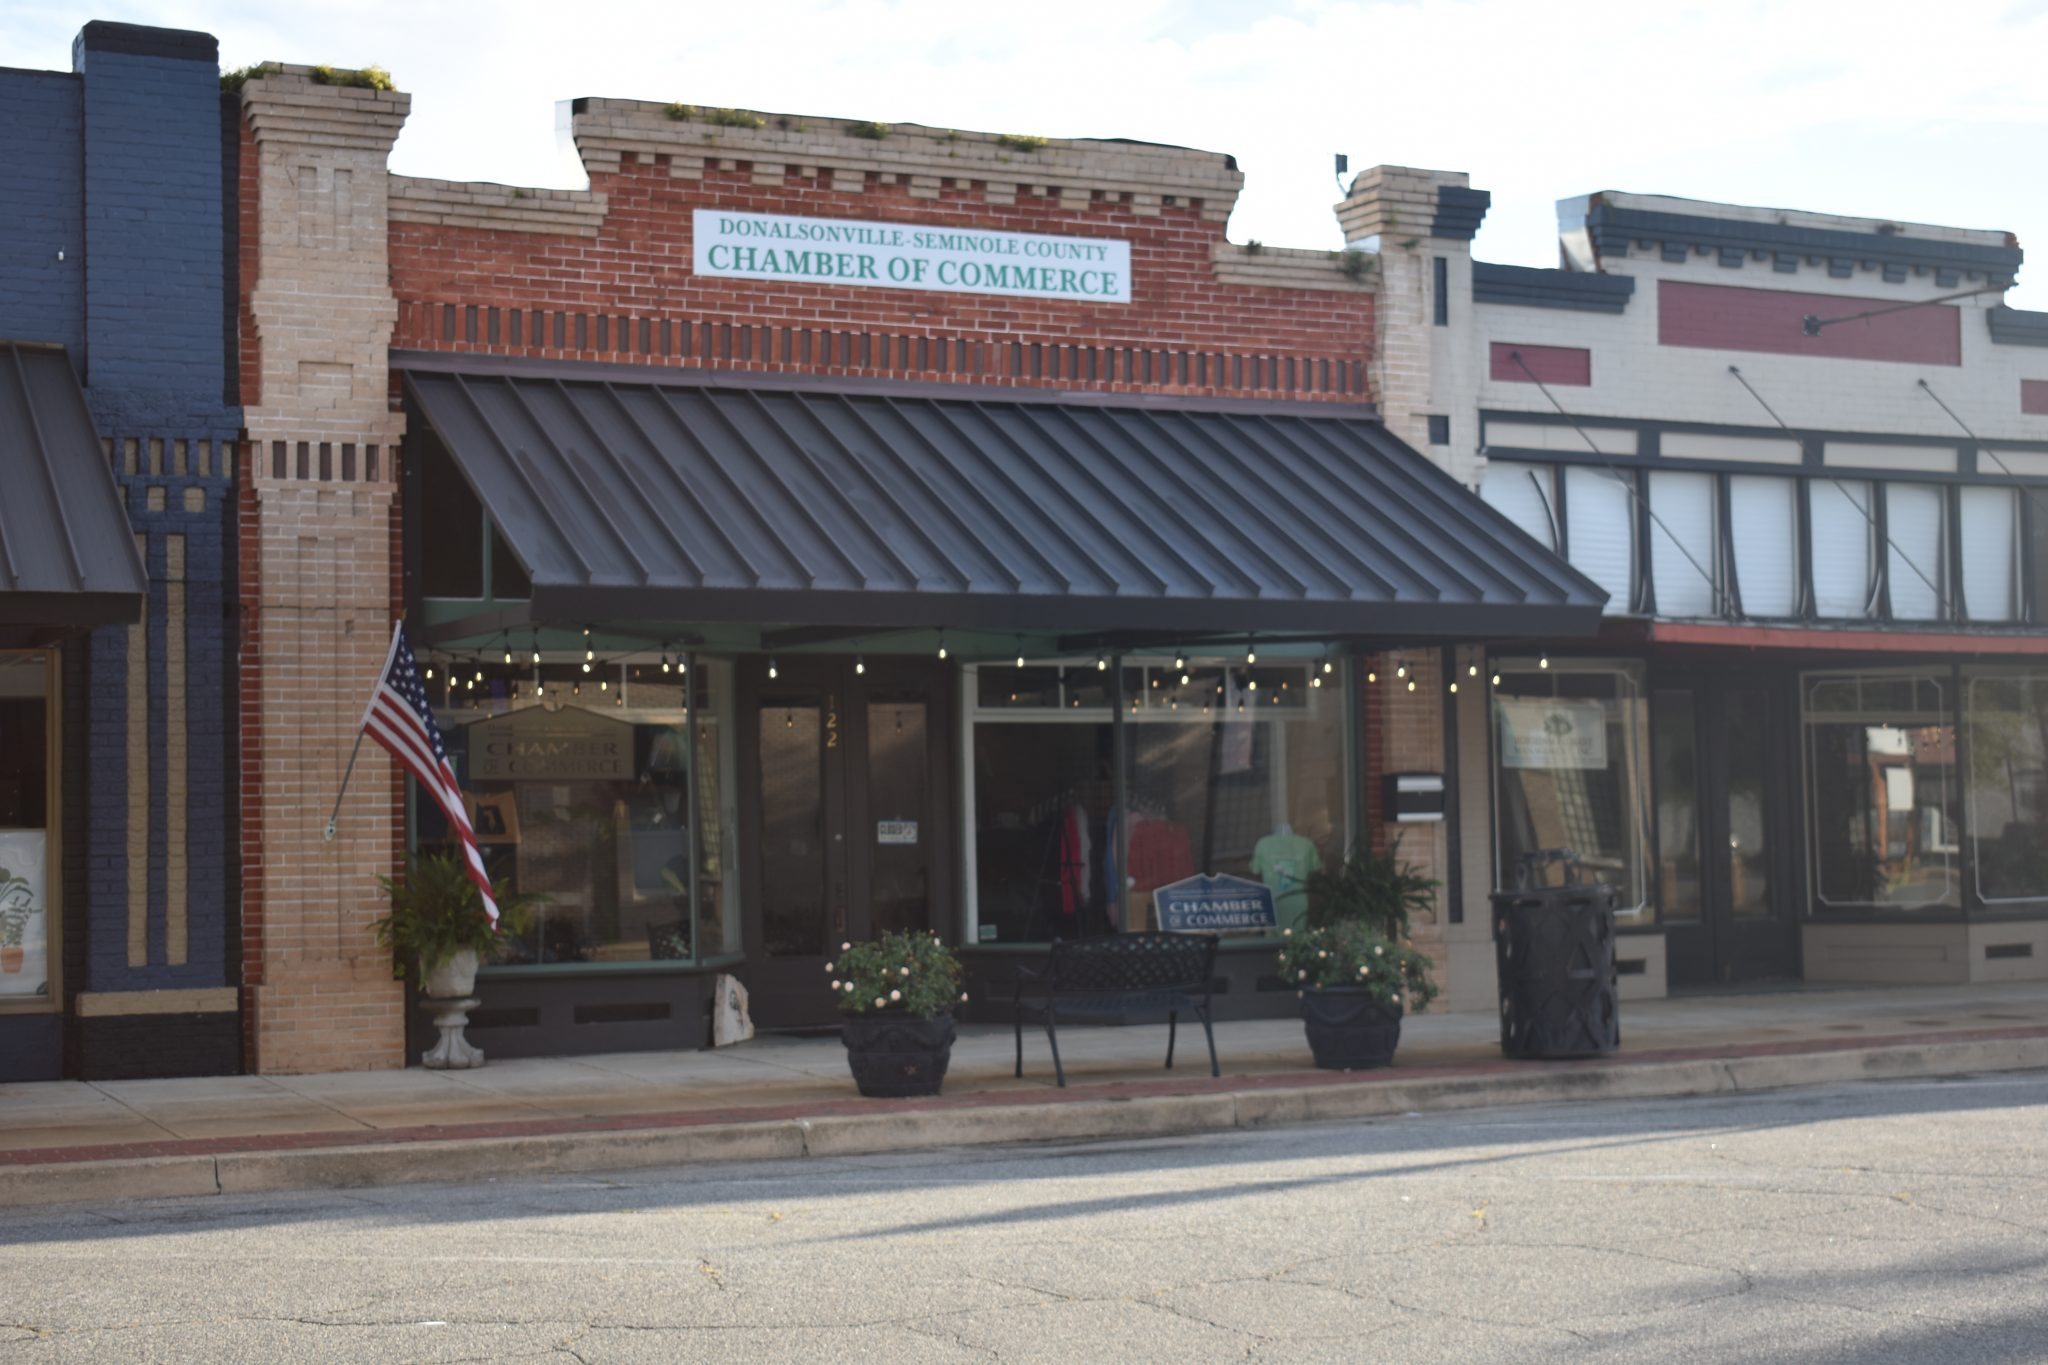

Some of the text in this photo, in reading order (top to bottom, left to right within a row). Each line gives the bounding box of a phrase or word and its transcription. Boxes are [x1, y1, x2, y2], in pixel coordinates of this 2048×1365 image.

[719, 218, 1108, 261] DONALSONVILLE-SEMINOLE COUNTY
[708, 244, 1119, 295] CHAMBER OF COMMERCE
[1168, 899, 1263, 913] CHAMBER
[1186, 912, 1269, 926] COMMERCE
